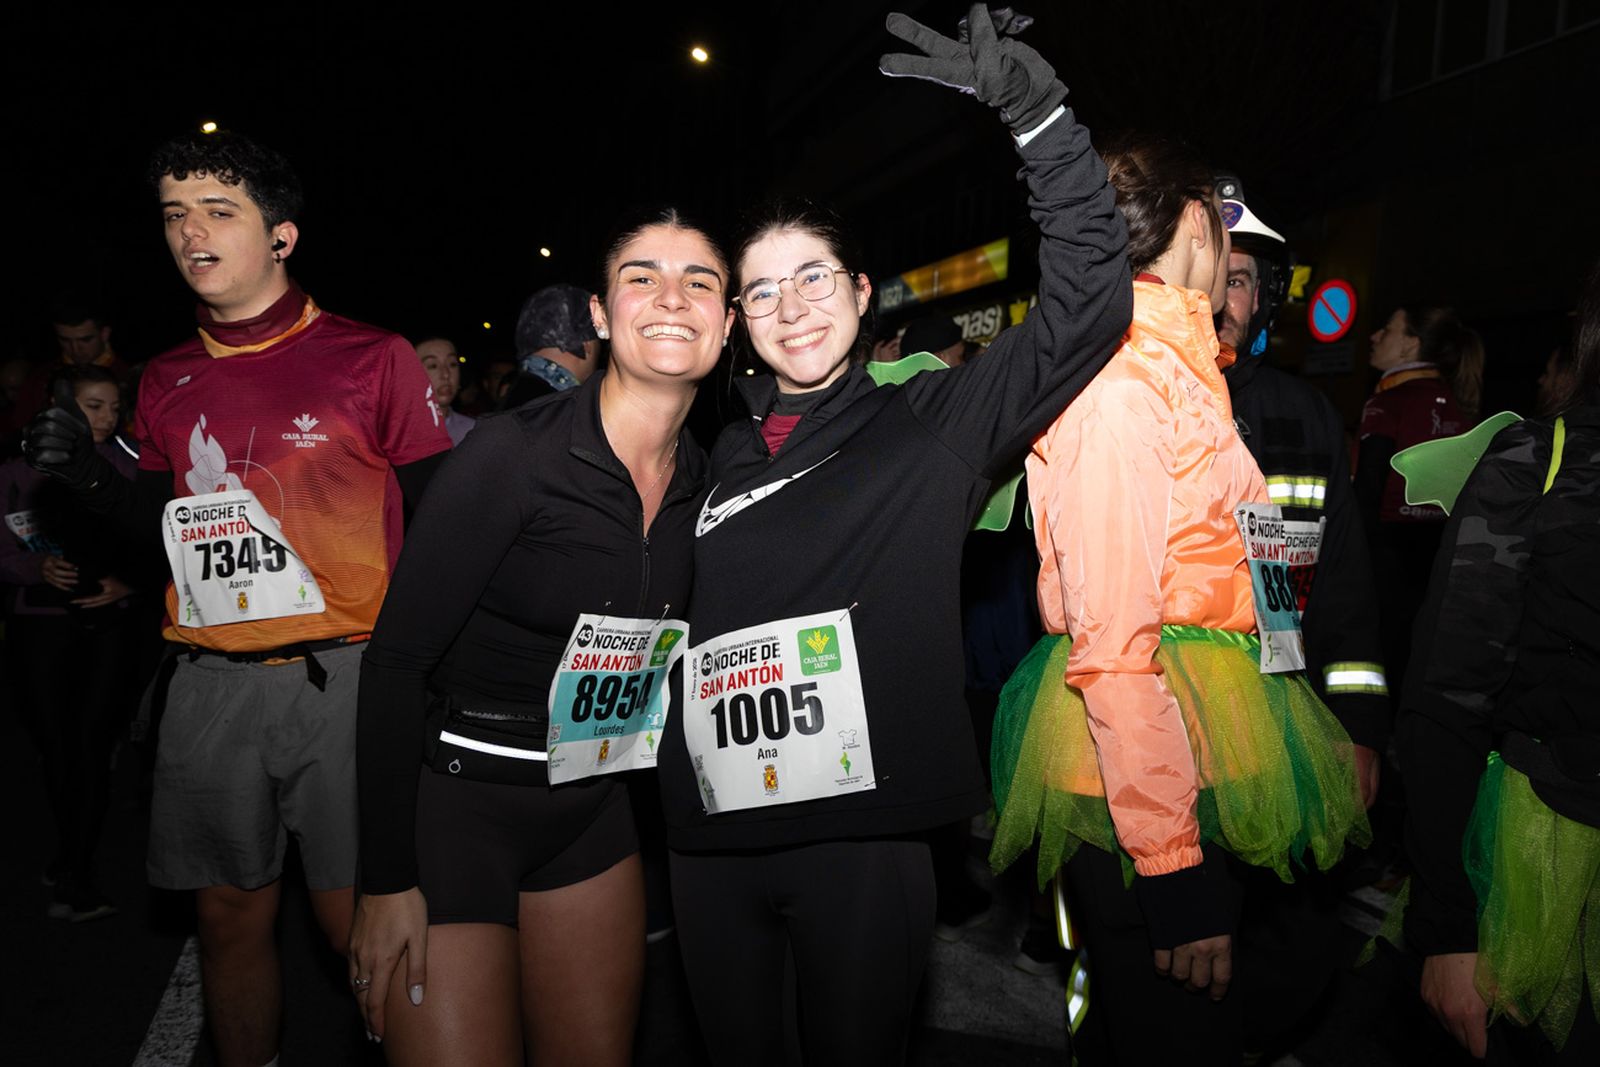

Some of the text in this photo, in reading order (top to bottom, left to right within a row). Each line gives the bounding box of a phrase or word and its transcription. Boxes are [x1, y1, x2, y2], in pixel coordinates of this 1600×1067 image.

[193, 506, 235, 523] NOCHE
[181, 526, 206, 543] SAN
[1257, 523, 1285, 539] NOCHE
[1251, 542, 1265, 559] SAN
[1286, 536, 1309, 548] OCHE
[195, 535, 287, 581] 7345
[229, 579, 253, 589] Aaron
[1261, 564, 1297, 612] 88
[592, 634, 650, 651] NOCHE DE
[571, 653, 601, 671] SAN
[714, 642, 781, 673] NOCHE DE
[700, 660, 783, 700] SAN ANTÓN
[571, 672, 655, 723] 8954
[711, 681, 824, 749] 1005
[593, 724, 625, 736] Lourdes
[757, 748, 778, 760] Ana
